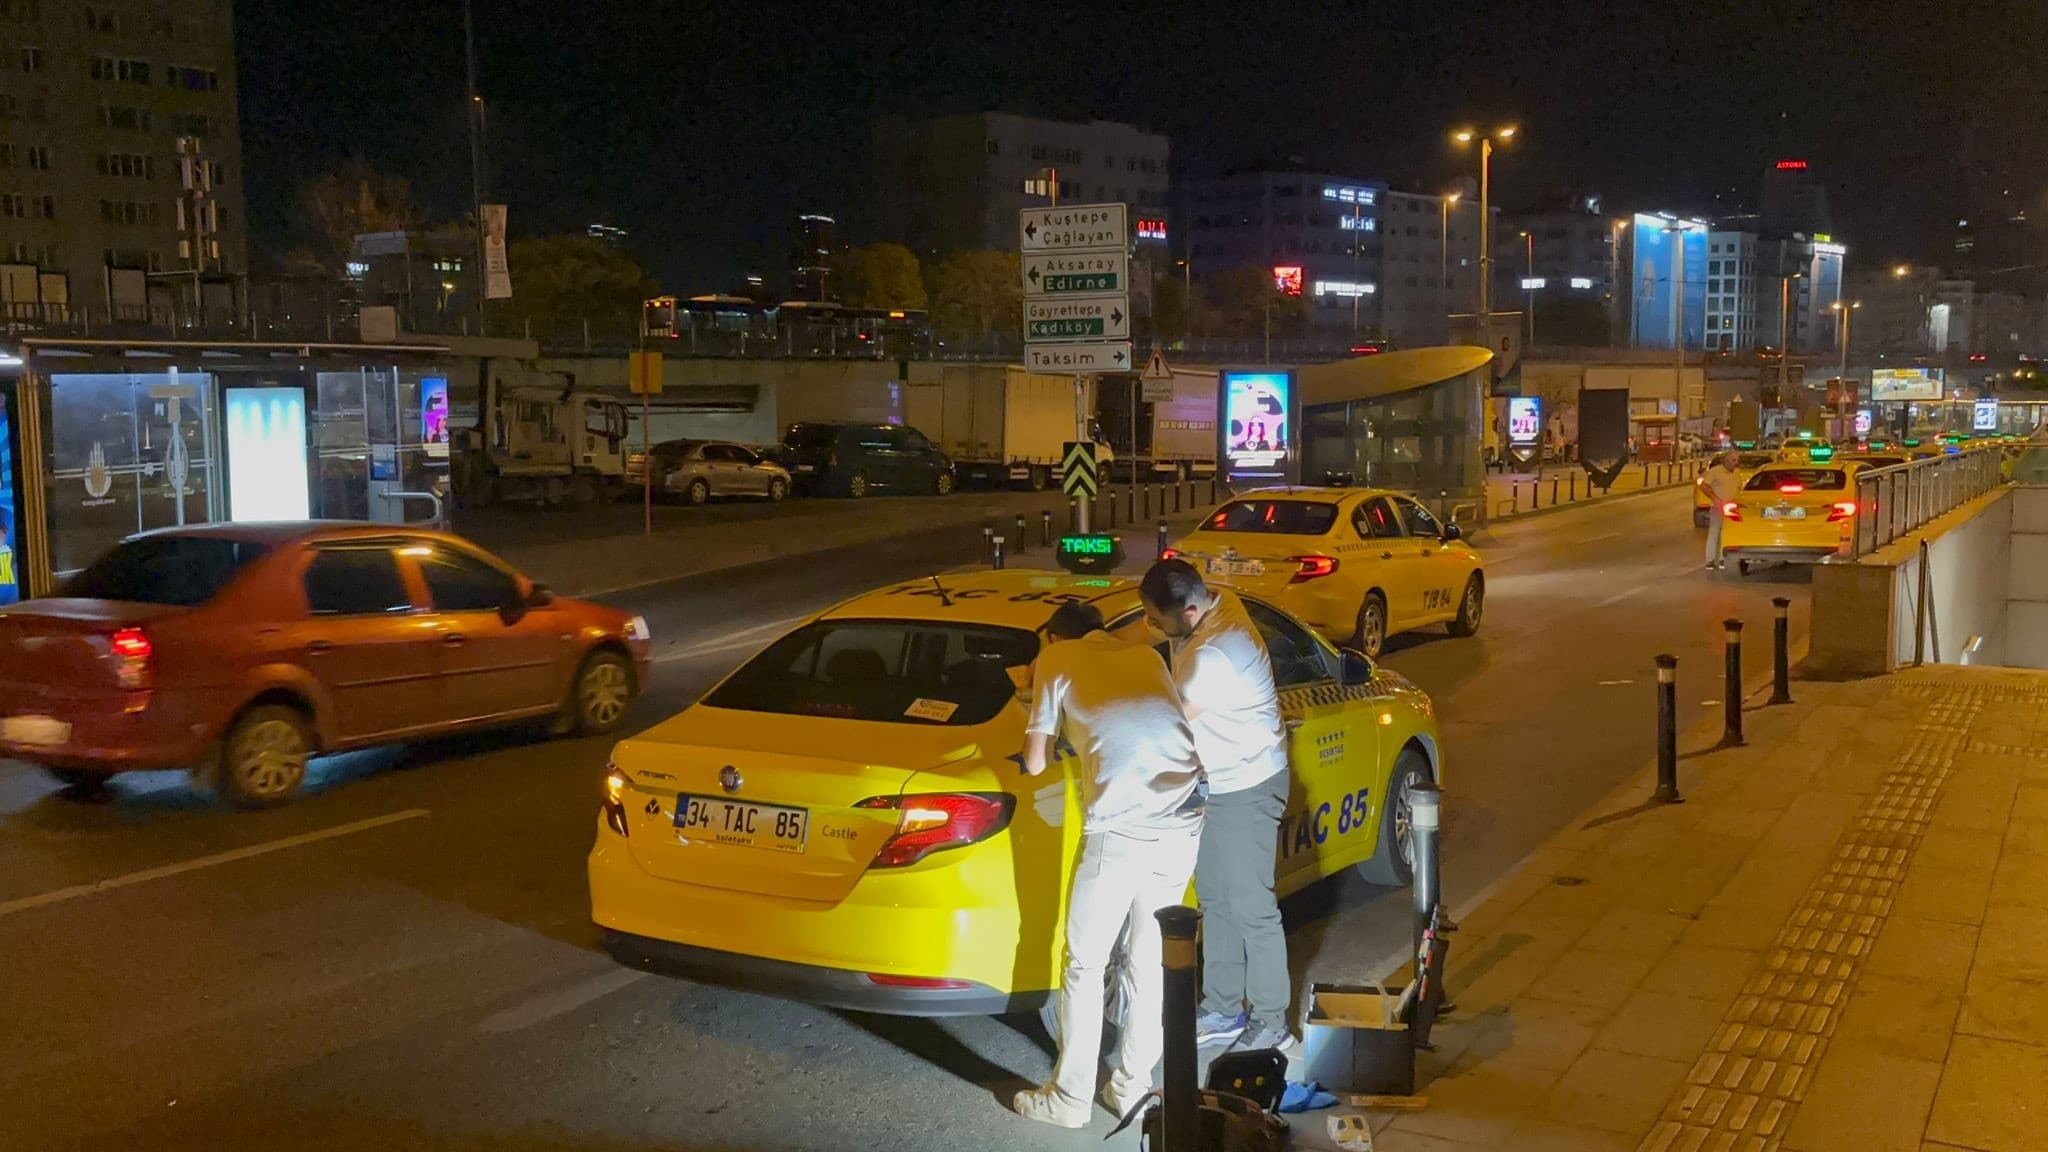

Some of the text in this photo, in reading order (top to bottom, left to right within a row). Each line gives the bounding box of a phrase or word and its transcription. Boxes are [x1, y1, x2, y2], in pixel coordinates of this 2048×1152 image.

[1043, 211, 1109, 226] Kuştepe
[1043, 231, 1114, 246] Çağlayan
[1046, 258, 1115, 272] Aksaray
[1045, 276, 1107, 290] Edirne
[1030, 304, 1102, 319] Gayrettepe
[1031, 321, 1093, 335] Kadıköy
[1032, 352, 1095, 366] Taksim
[687, 801, 800, 839] 34 TAC 85
[1278, 787, 1369, 860] TAC 85
[822, 824, 858, 841] Castle
